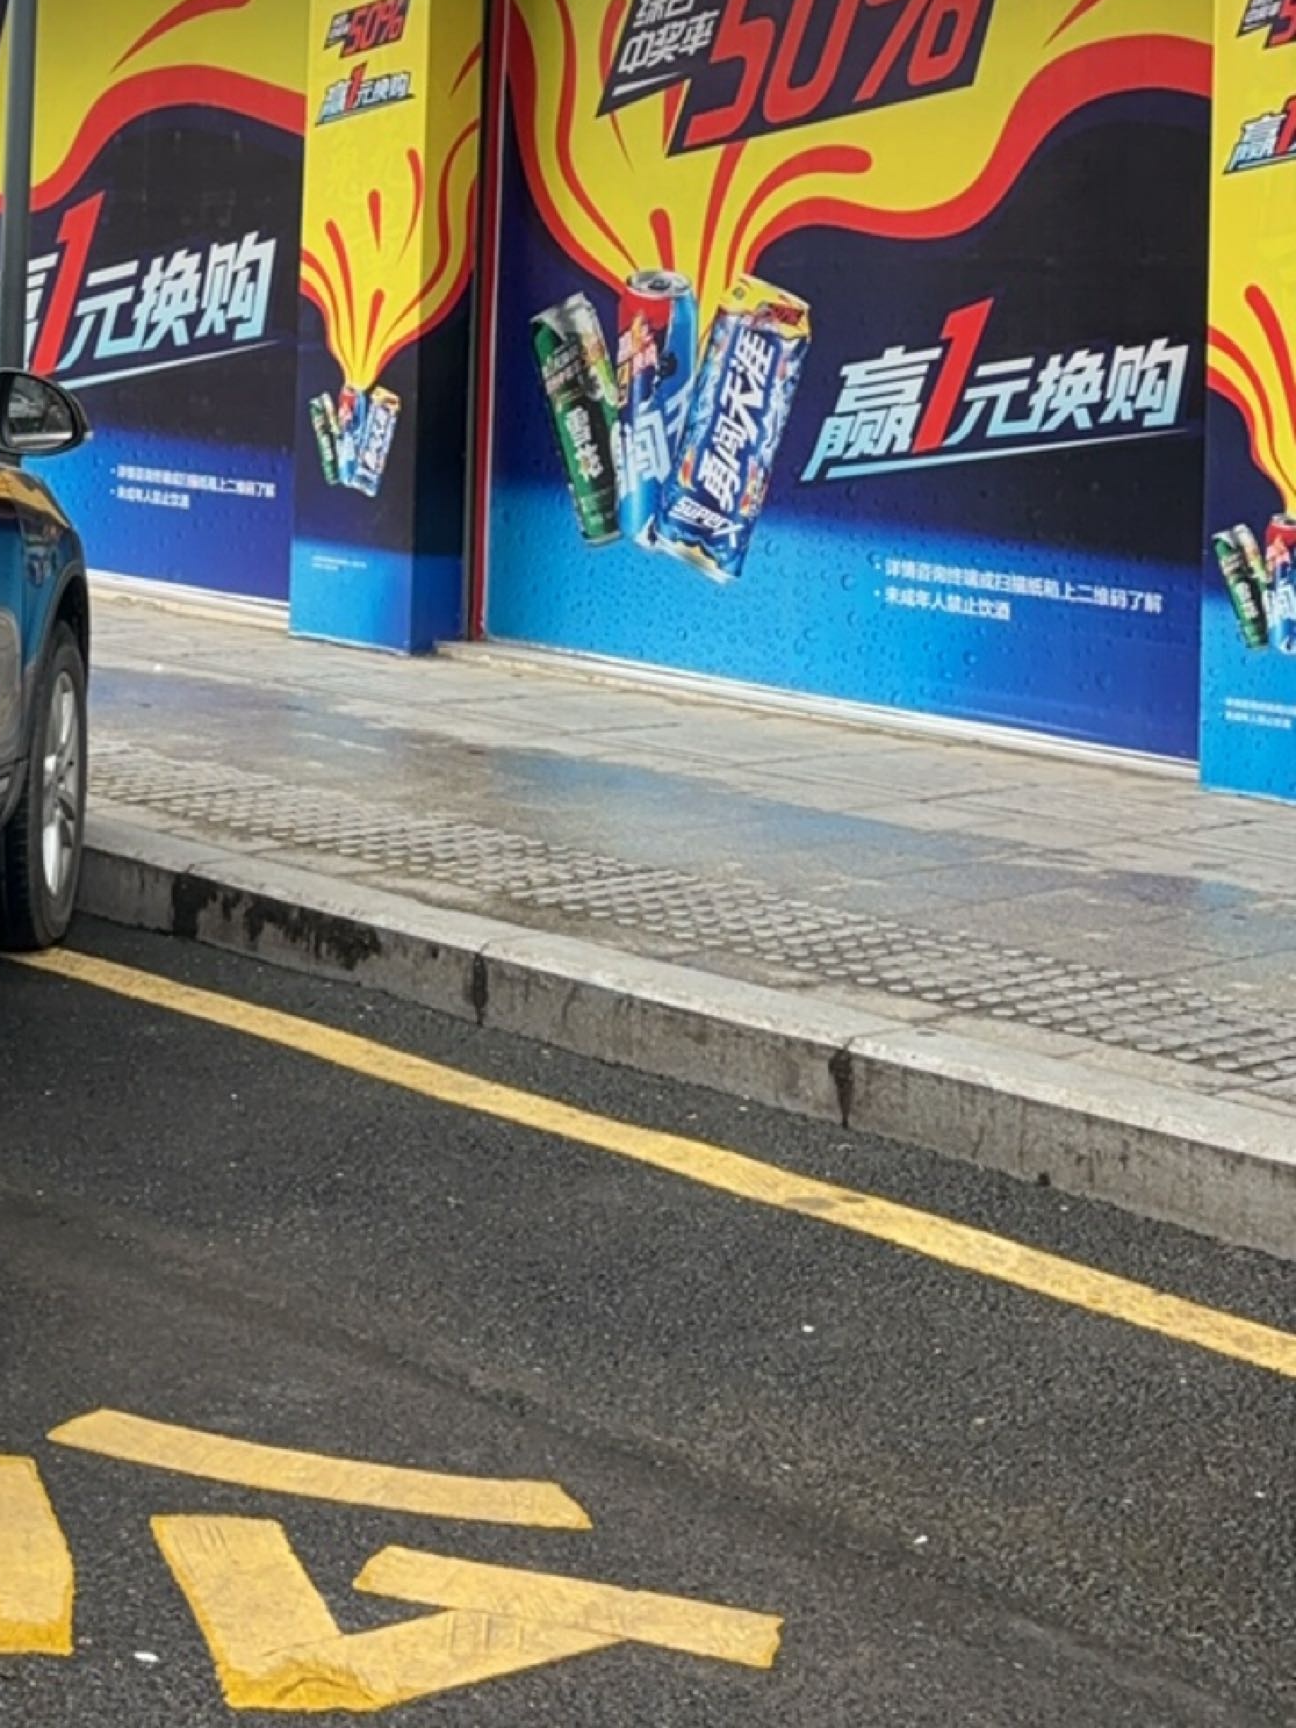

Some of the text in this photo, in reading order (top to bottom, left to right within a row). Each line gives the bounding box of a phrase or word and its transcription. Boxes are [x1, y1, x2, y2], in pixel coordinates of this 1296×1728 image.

[619, 9, 720, 73] 中奖率
[800, 297, 1189, 482] 赢1元换购
